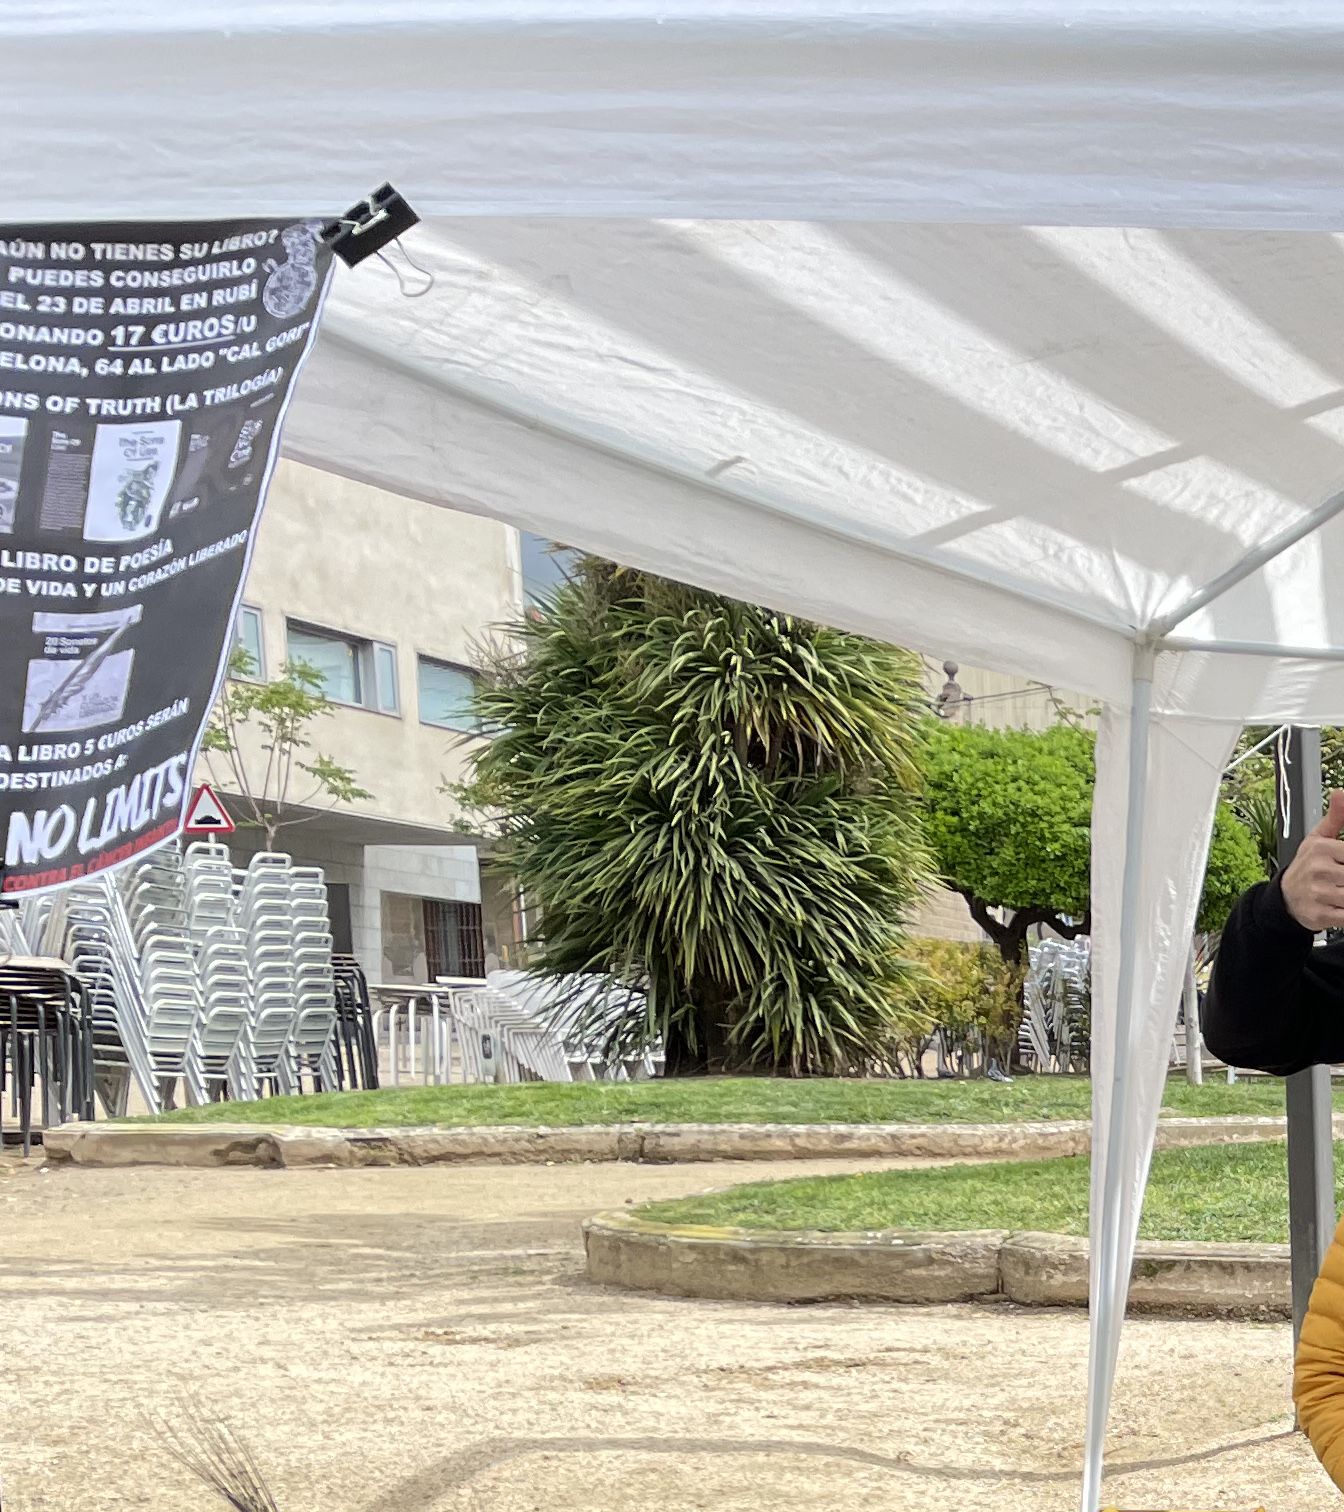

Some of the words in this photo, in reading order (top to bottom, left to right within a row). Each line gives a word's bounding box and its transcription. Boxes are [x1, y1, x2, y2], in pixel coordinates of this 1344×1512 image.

[50, 243, 86, 262] NO
[90, 243, 175, 262] TIENES
[179, 241, 209, 259] SU
[210, 229, 279, 256] LIBRO?
[7, 266, 104, 288] PUEDES
[109, 257, 258, 288] CONSEGUIRLO
[36, 295, 67, 315] 23
[72, 296, 105, 315] DE
[109, 291, 176, 315] ABRIL
[180, 288, 208, 311] EN
[211, 278, 259, 307] RUBÍ
[111, 323, 143, 346] 17
[94, 354, 124, 376] 64
[127, 355, 157, 376] AL
[160, 349, 216, 374] LADO
[45, 393, 80, 415] OF
[85, 396, 161, 417] TRUTH
[165, 394, 199, 418] (LA
[202, 366, 285, 406] TRILOGÍA)
[1, 549, 79, 573] LIBRO
[83, 554, 115, 573] DE
[118, 538, 174, 573] POESÍA
[25, 579, 78, 598] VIDA
[82, 580, 98, 599] Y
[100, 579, 125, 597] UN
[188, 529, 249, 567] LIBERADO
[18, 742, 82, 763] LIBRO
[84, 738, 96, 756] 5
[146, 697, 190, 732] SERÁN
[5, 803, 78, 866] NO
[77, 750, 188, 855] LIMITS
